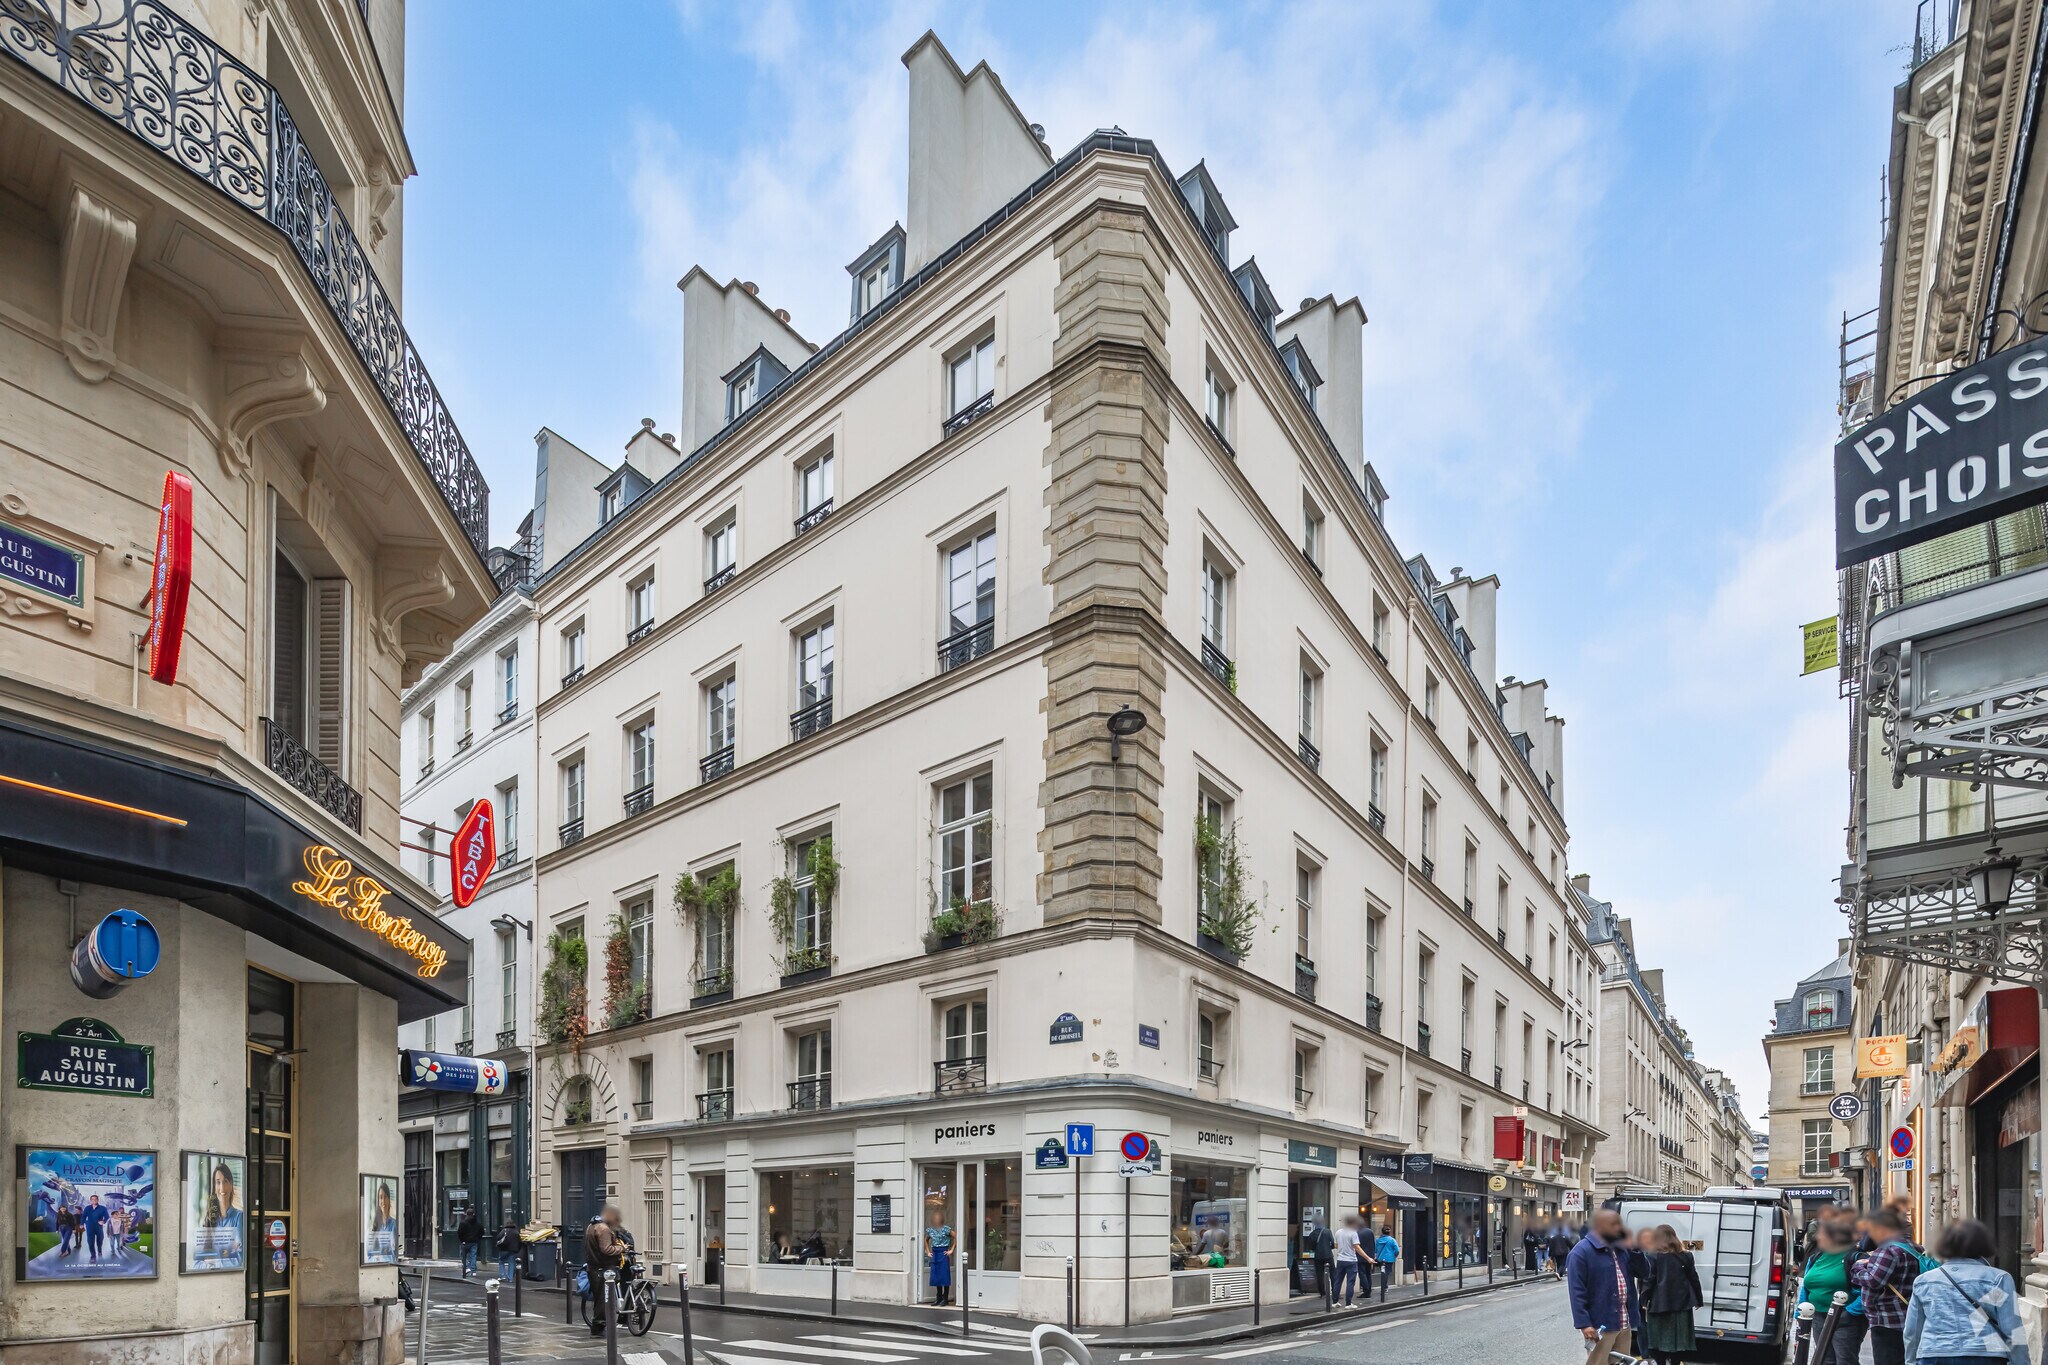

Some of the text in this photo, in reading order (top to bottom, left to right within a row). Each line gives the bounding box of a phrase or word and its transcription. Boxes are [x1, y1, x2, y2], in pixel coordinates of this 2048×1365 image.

[1812, 624, 1837, 639] SERVICES
[462, 814, 489, 889] TABAC
[292, 845, 447, 977] Le Fontenoy
[70, 1046, 107, 1060] RUE
[61, 1059, 116, 1074] SAINT
[40, 1070, 135, 1088] AUGUSTIN
[935, 1120, 996, 1144] paniers
[1198, 1128, 1233, 1146] paniers
[62, 1163, 125, 1177] HAROLD
[1889, 1161, 1905, 1169] SAUF
